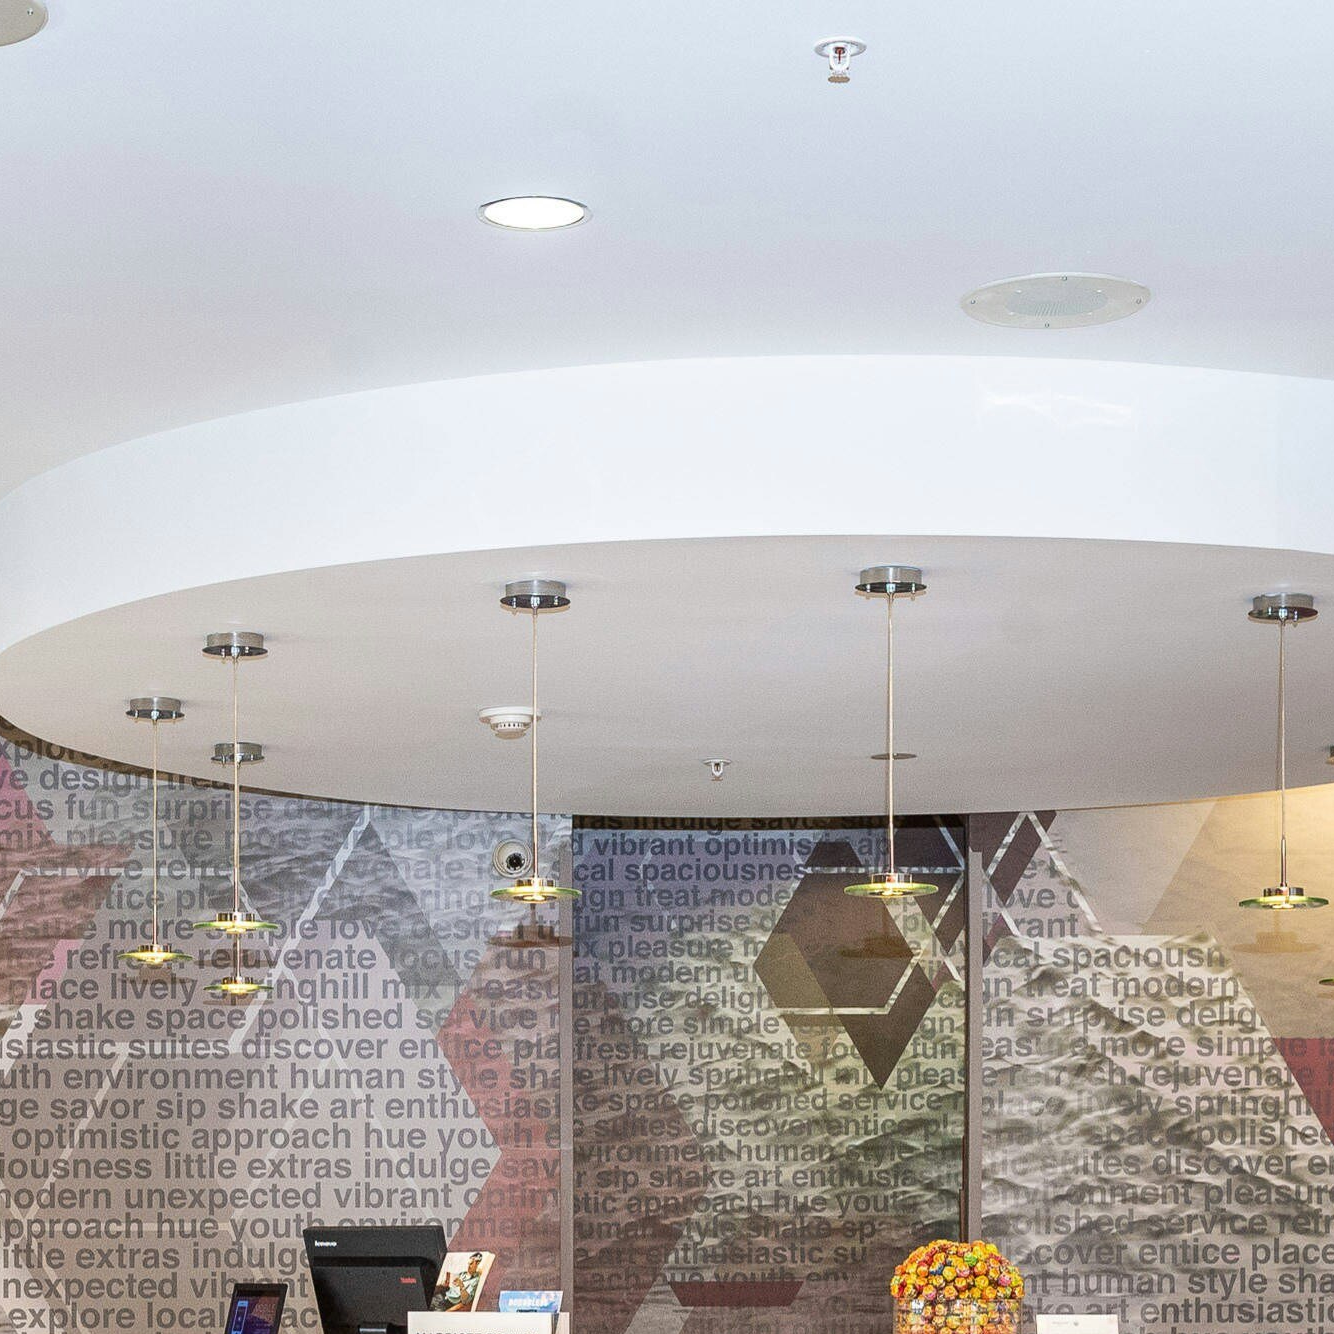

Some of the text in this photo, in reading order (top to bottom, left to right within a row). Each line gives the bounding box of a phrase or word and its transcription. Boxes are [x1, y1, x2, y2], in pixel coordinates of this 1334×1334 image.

[40, 765, 151, 798] design
[67, 795, 121, 820] fun
[133, 795, 273, 828] surprise
[594, 834, 696, 856] vibrant
[635, 884, 701, 905] treat
[109, 919, 194, 939] more
[574, 909, 751, 937] fun surprise
[198, 944, 377, 976] rejuvenate
[608, 934, 734, 962] pleasure
[611, 961, 721, 983] modern
[1026, 973, 1100, 997] treat
[1112, 972, 1239, 997] modern
[32, 973, 442, 1006] place lively mix
[34, 1004, 538, 1036] shake space polished service
[600, 1012, 780, 1040] more simple
[1027, 1001, 1165, 1034] surprise
[127, 1033, 230, 1059] suites
[241, 1033, 386, 1059] discover
[398, 1033, 502, 1059] entice
[660, 1038, 807, 1066] rejuvenate
[912, 1038, 958, 1060] fun
[1101, 1036, 1185, 1056] more
[1196, 1031, 1307, 1063] simple
[63, 1063, 278, 1089] environment
[291, 1063, 405, 1089] human
[417, 1063, 498, 1096] style
[604, 1063, 678, 1091] lively
[688, 1063, 824, 1091] springhill
[1140, 1060, 1314, 1093] rejuvenate
[50, 1093, 374, 1126] savor sip shake art
[608, 1089, 944, 1117] space polished service
[1175, 1090, 1331, 1122] springhill
[595, 1114, 917, 1136] suites discover entice
[12, 1123, 180, 1156] optimistic
[191, 1123, 351, 1156] approach
[365, 1123, 426, 1148] hue
[437, 1123, 533, 1156] youth
[736, 1140, 834, 1162] human
[166, 1153, 236, 1178] little
[247, 1154, 352, 1178] extras
[365, 1153, 491, 1186] indulge
[1152, 1150, 1297, 1175] discover
[596, 1166, 783, 1194] sip shake art
[124, 1183, 322, 1215] unexpected
[334, 1183, 451, 1208] vibrant
[626, 1191, 763, 1219] approach
[774, 1191, 827, 1213] hue
[157, 1213, 219, 1238] hue
[1149, 1209, 1268, 1234] service
[76, 1244, 180, 1268] extras
[192, 1243, 310, 1275] indulge
[1138, 1238, 1240, 1264] entice
[1063, 1268, 1175, 1294] human
[1187, 1268, 1268, 1300] style
[10, 1303, 135, 1334] explore
[146, 1303, 225, 1328] local
